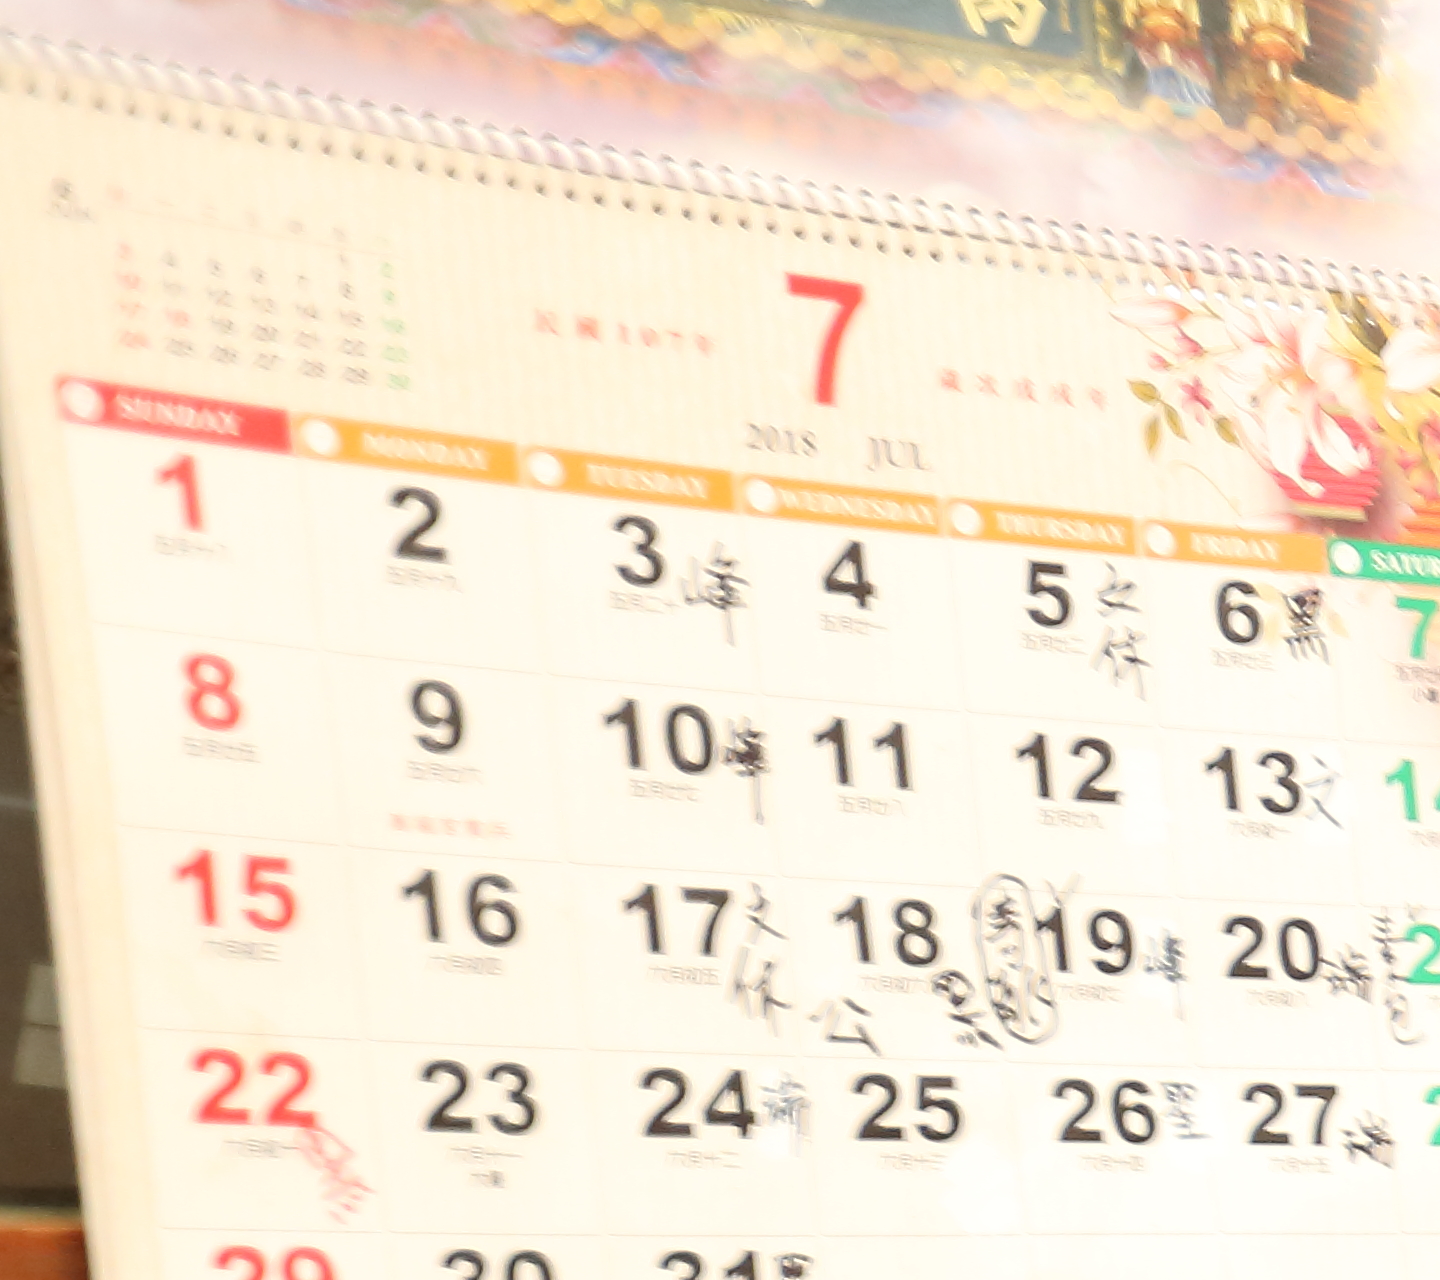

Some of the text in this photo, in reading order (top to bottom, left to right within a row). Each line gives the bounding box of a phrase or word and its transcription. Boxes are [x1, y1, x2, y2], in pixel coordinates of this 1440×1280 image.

[785, 271, 864, 409] 7
[115, 392, 243, 438] SUNDAY
[360, 430, 491, 473] MONDAY
[584, 461, 711, 500] TUESDAY
[778, 487, 937, 528] WEDNESDAY
[996, 510, 1128, 548] THURSDAY
[1190, 530, 1282, 563] FRIDAY
[745, 420, 931, 472] 2018 JUL
[155, 453, 1440, 660] 1 2 3 4 5 6 7
[182, 652, 241, 732] 8
[410, 679, 464, 755] 9
[603, 698, 714, 776] 10
[813, 717, 914, 792] 11
[1015, 733, 1124, 805] 12
[1205, 747, 1302, 815] 13
[174, 848, 298, 934] 15
[401, 868, 520, 948] 16
[622, 883, 735, 957] 17
[832, 895, 942, 967] 18
[1035, 904, 1136, 976] 19
[1222, 916, 1322, 982] 20
[190, 1047, 318, 1127] 22
[417, 1059, 541, 1137] 23
[640, 1067, 757, 1138] 24
[852, 1072, 963, 1142] 25
[1052, 1079, 1157, 1145] 26
[1241, 1082, 1341, 1147] 27
